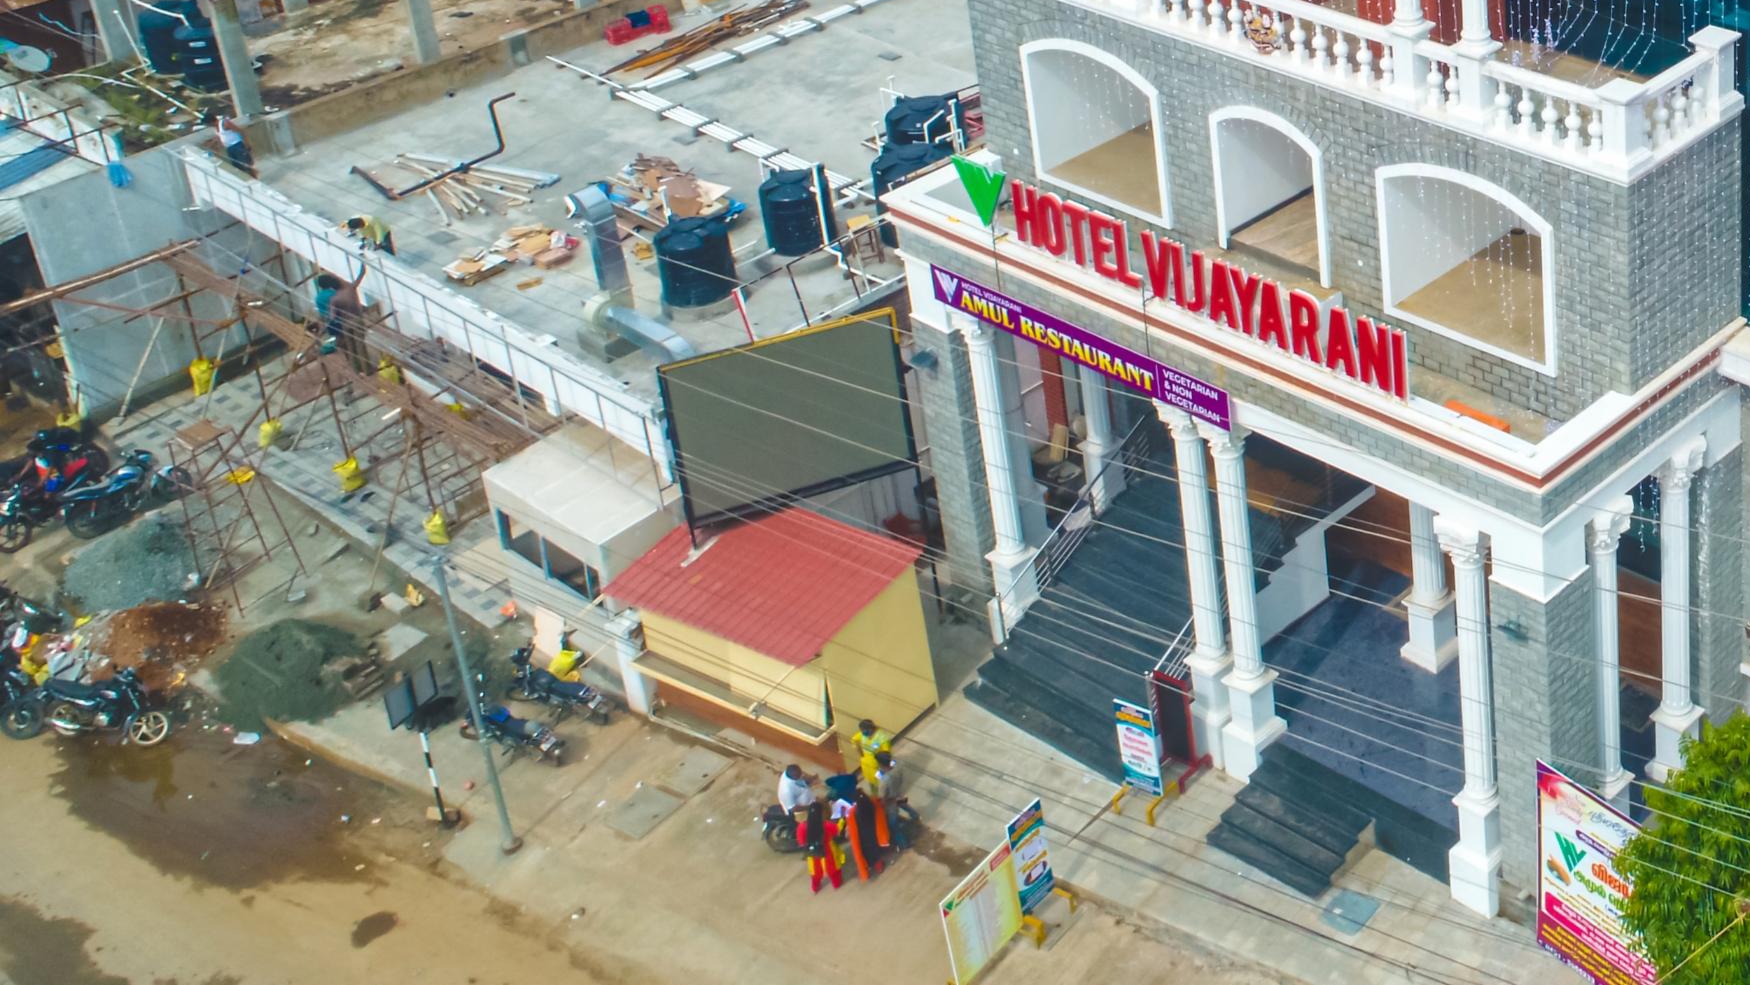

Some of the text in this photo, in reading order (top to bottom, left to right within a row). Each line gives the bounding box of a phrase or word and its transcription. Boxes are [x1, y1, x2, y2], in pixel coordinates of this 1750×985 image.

[961, 281, 983, 296] HOTEL
[1010, 178, 1411, 403] HOTEL VIJAYARANI
[961, 290, 1155, 392] AMUL RESTAURANT
[1162, 368, 1219, 401] VEGETARIAN
[1164, 380, 1193, 400] & NON
[1165, 390, 1221, 423] VEGETARIAN
